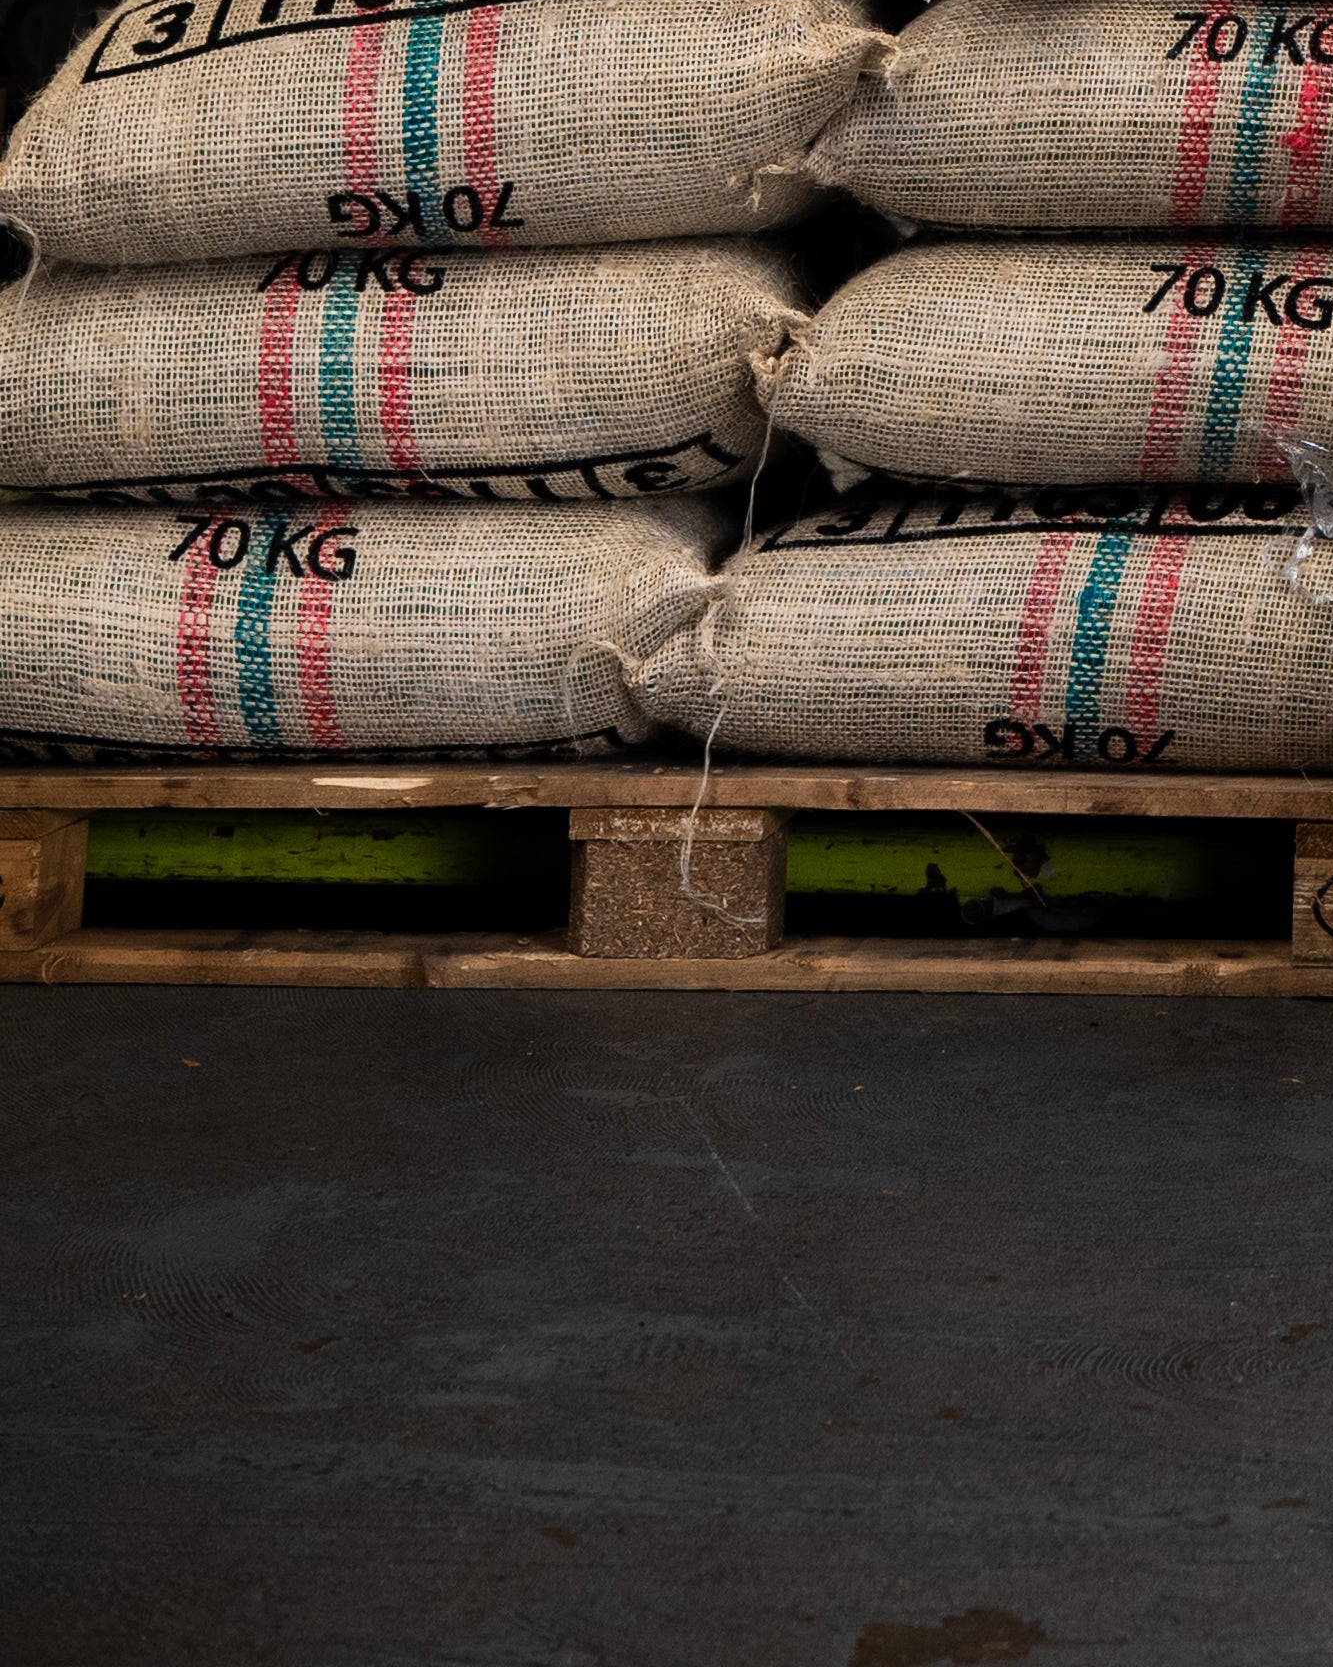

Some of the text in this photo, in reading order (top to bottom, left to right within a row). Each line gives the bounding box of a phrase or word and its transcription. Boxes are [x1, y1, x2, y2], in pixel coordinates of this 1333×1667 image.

[132, 2, 194, 57] 3
[1165, 11, 1249, 63] 70
[326, 181, 525, 237] 70 KG
[354, 250, 445, 296] KG
[1142, 264, 1227, 318] 70
[167, 513, 359, 583] 70 KG
[983, 717, 1180, 765] 70 KG
